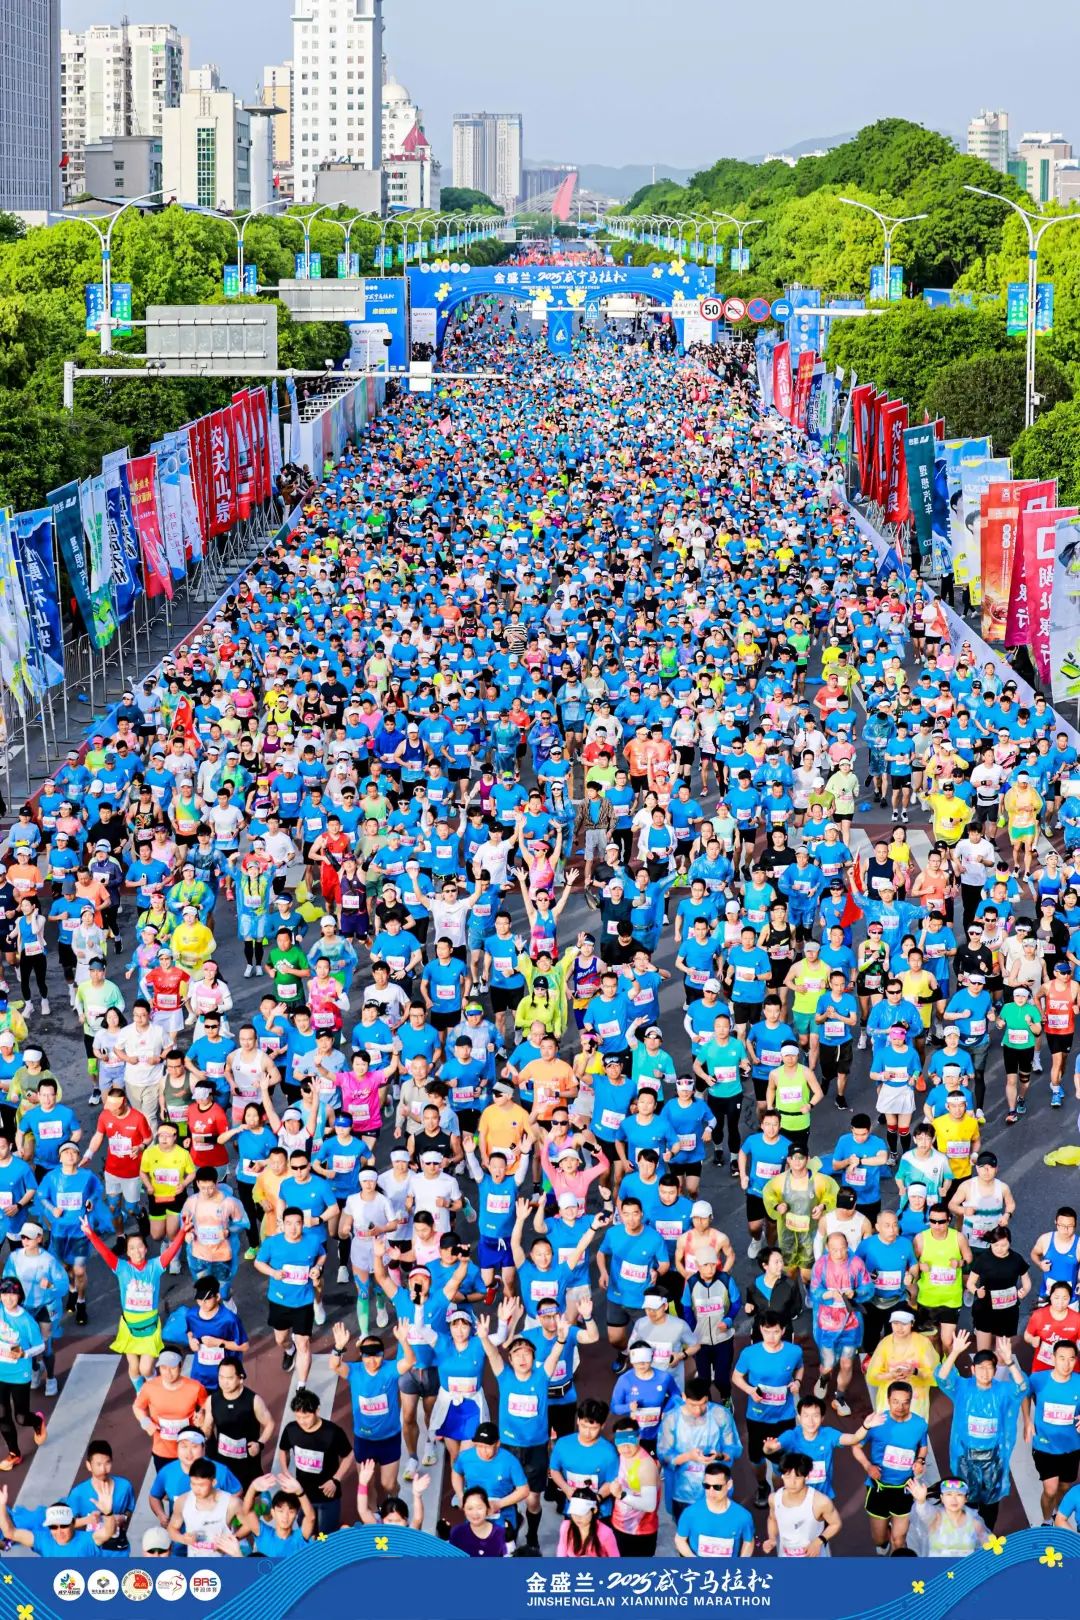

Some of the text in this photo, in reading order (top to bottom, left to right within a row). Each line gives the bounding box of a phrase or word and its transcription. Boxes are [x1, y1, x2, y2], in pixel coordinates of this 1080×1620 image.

[704, 304, 719, 316] 50
[210, 425, 232, 523] 农夫山泉
